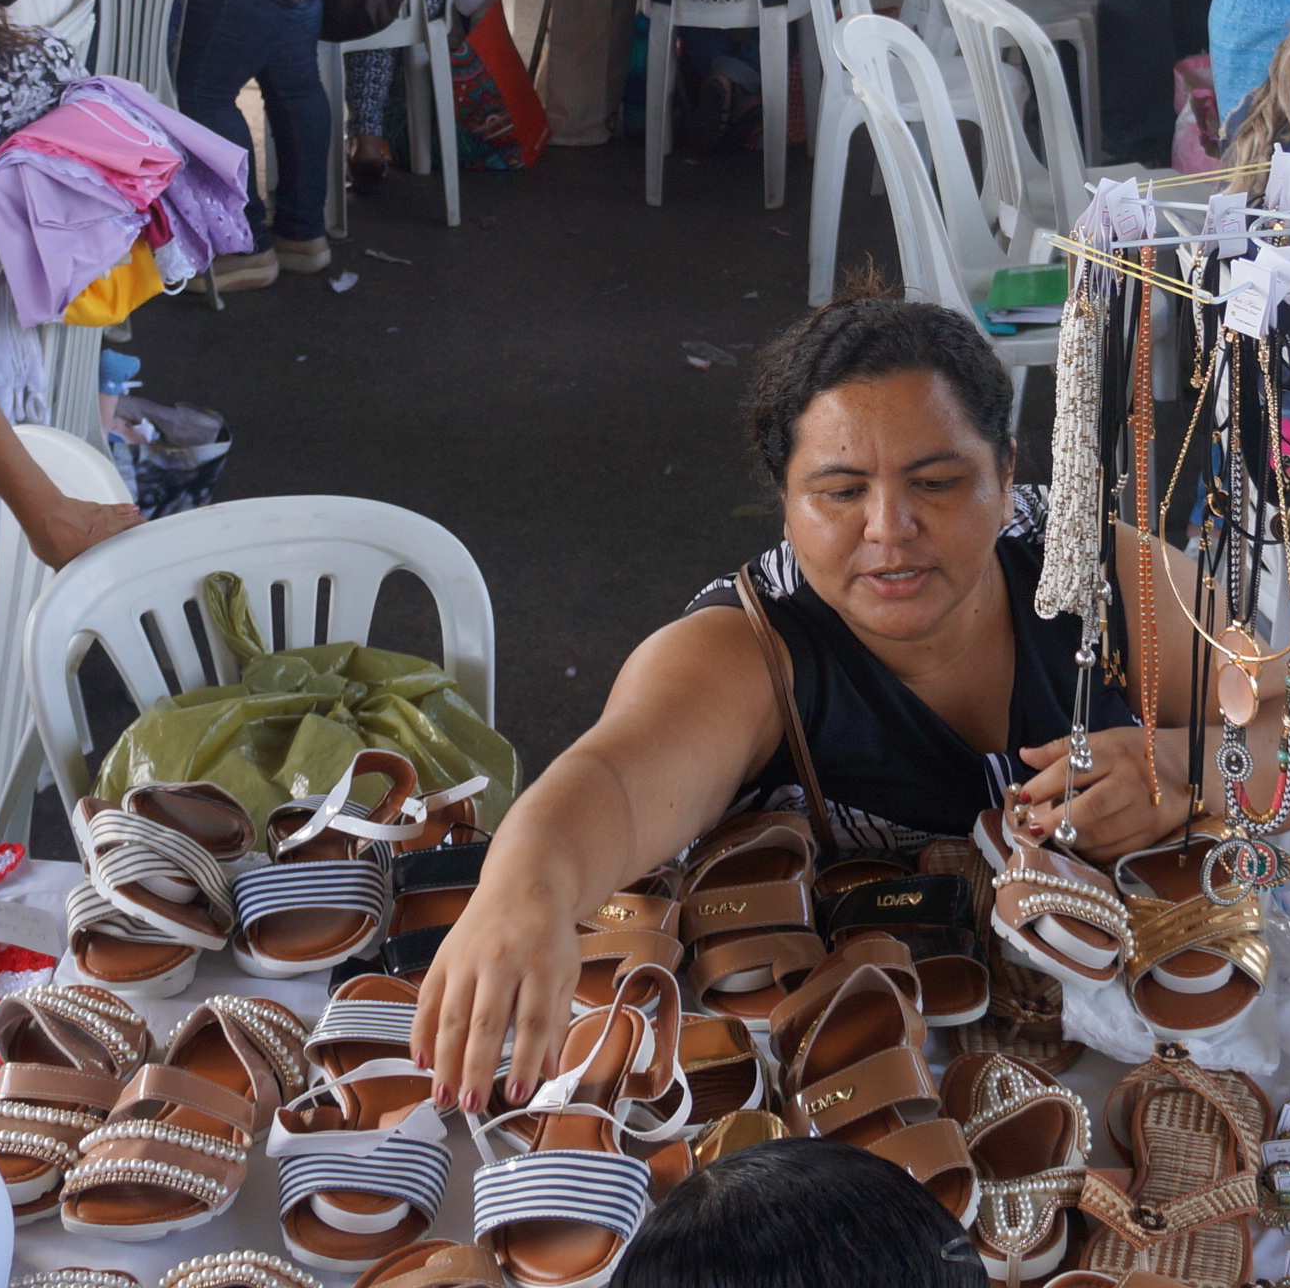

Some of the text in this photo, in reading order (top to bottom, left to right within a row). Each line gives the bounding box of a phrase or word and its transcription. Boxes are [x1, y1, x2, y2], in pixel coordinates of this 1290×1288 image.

[877, 894, 909, 907] LOVE
[698, 901, 731, 916] LOVE
[805, 1093, 838, 1116] LOVE
